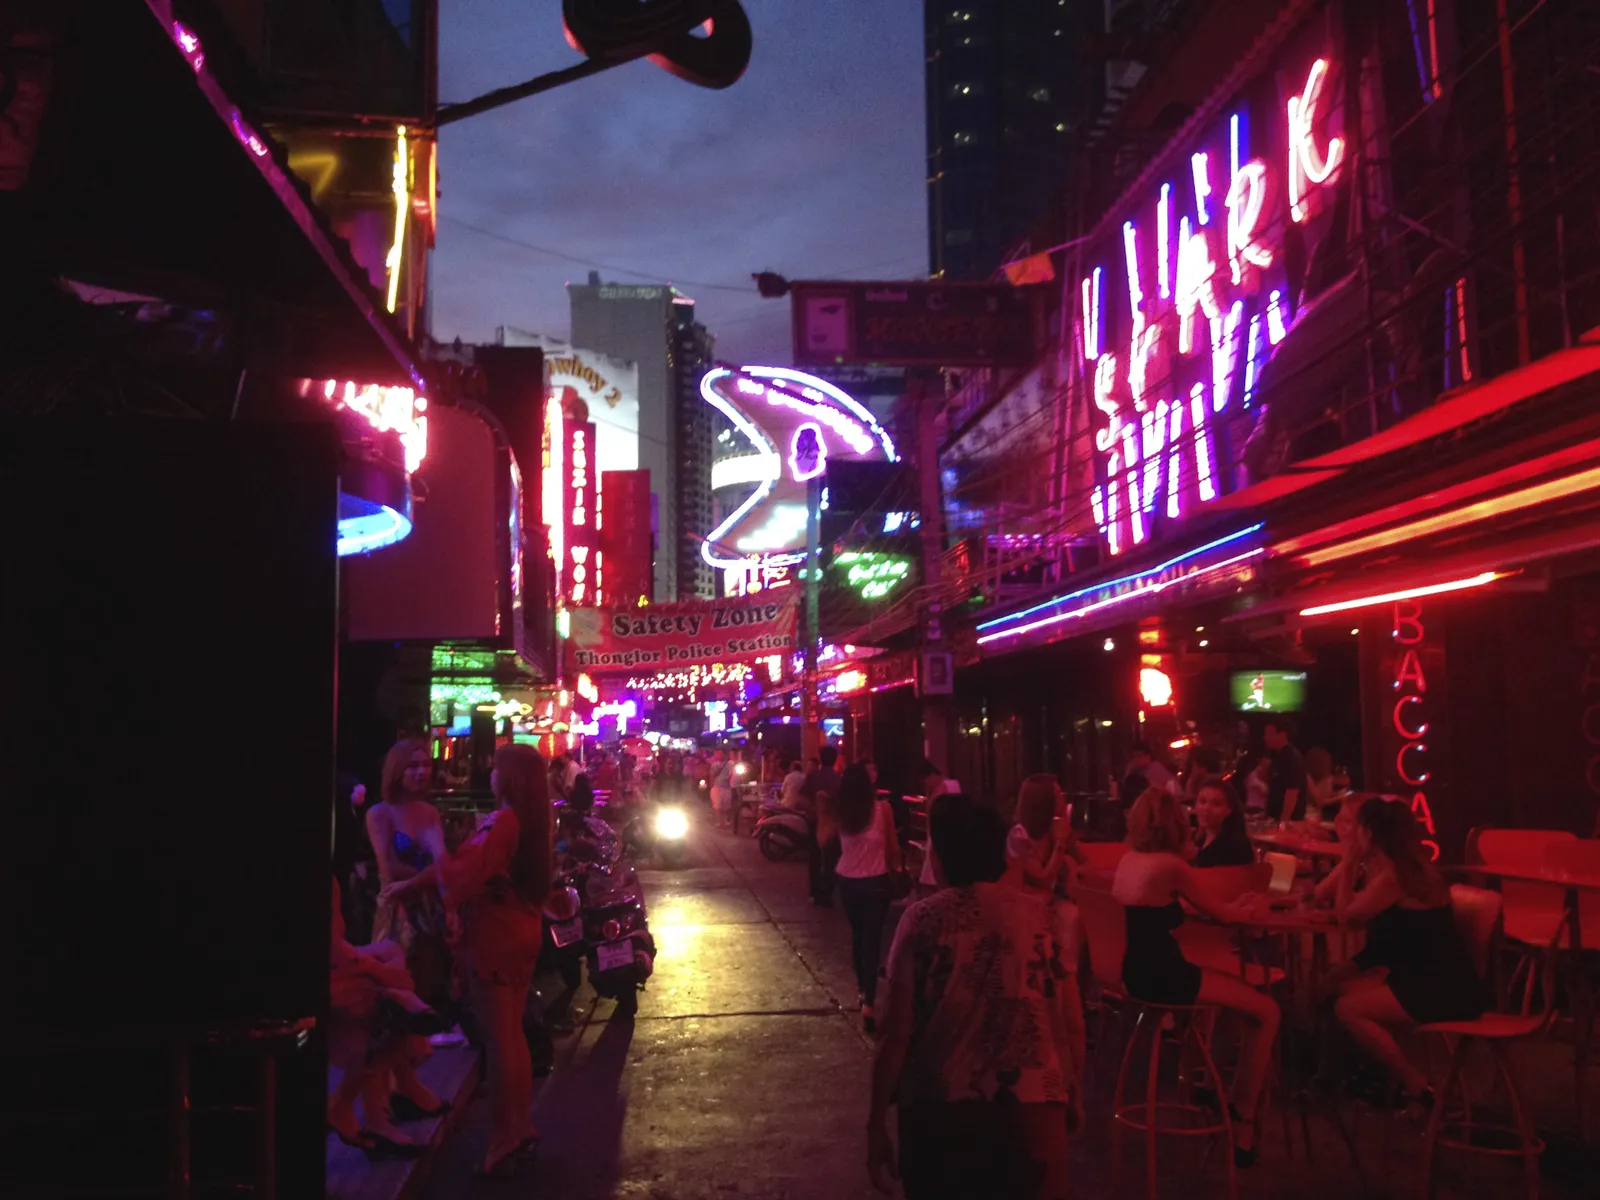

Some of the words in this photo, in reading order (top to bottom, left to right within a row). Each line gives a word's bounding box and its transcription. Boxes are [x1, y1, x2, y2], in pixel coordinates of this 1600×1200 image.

[605, 386, 623, 408] 2
[613, 612, 702, 636] Safety
[711, 604, 780, 629] Zone
[575, 648, 662, 667] Thonglor
[667, 643, 723, 661] Police
[727, 632, 793, 654] Station
